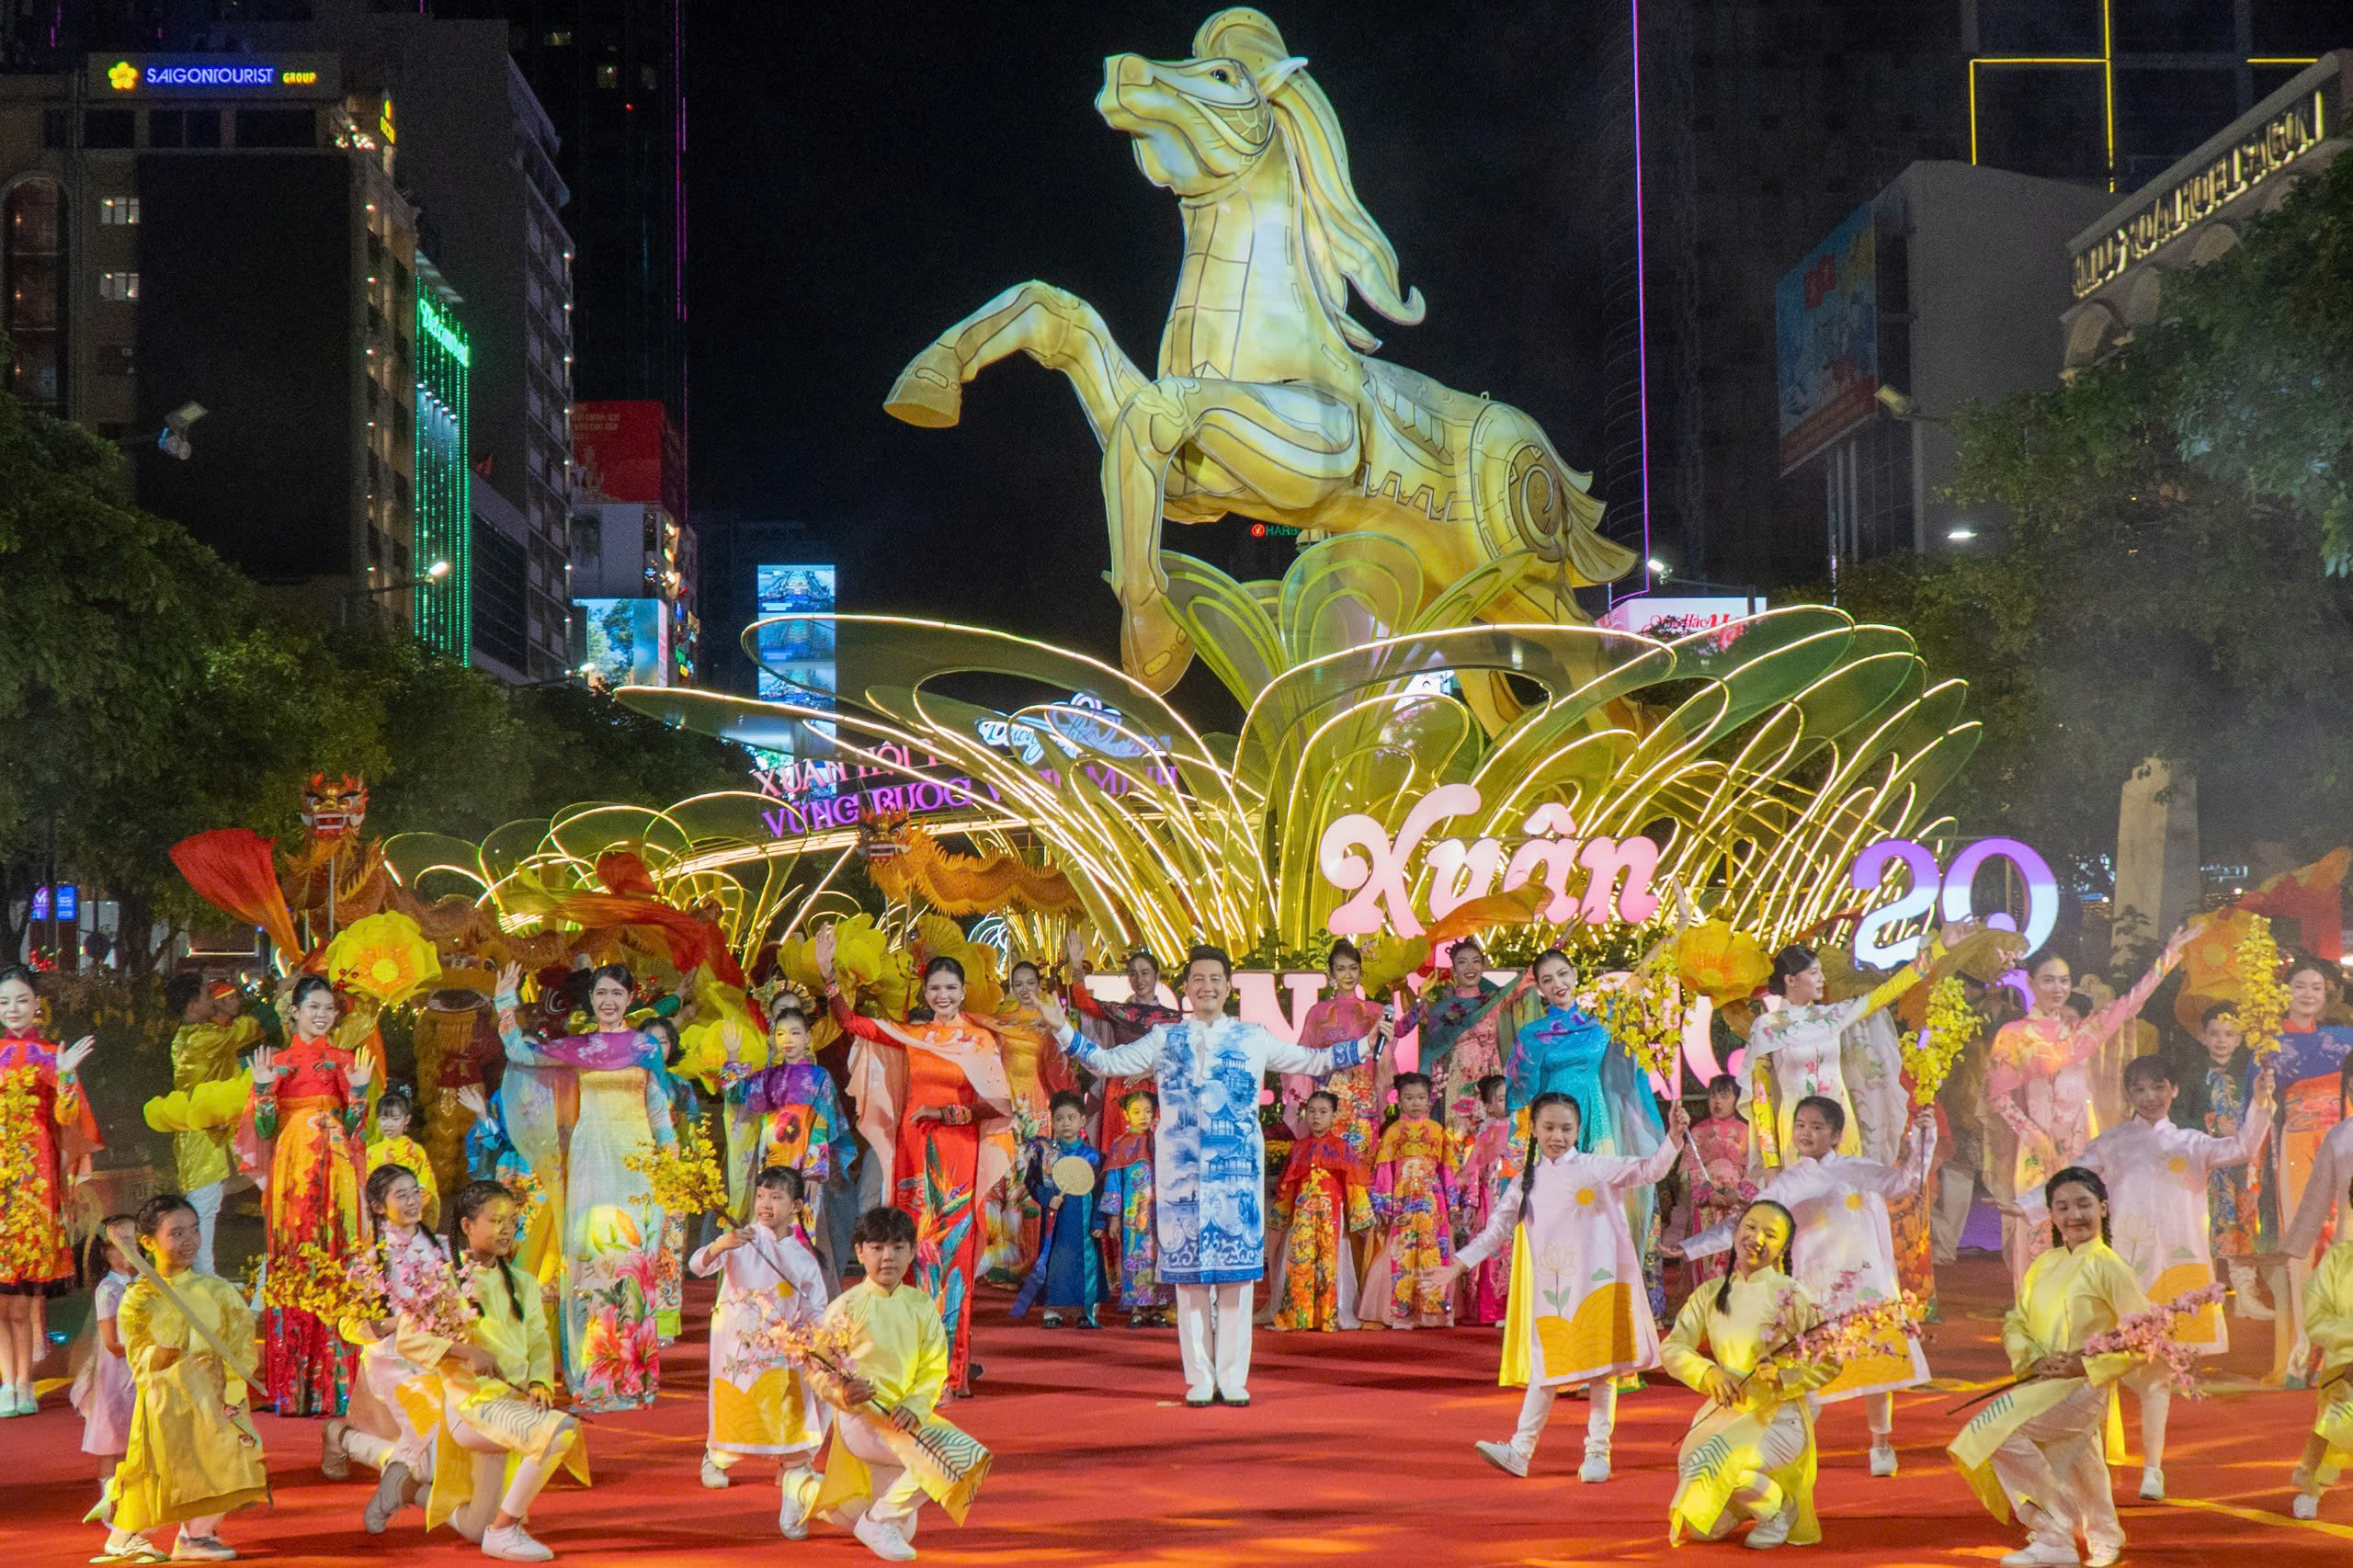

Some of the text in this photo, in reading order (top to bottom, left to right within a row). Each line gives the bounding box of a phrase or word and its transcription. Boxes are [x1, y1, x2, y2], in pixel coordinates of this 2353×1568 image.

[146, 68, 316, 84] SAIGONTOURIST GROUP
[1319, 783, 1660, 939] Xuân
